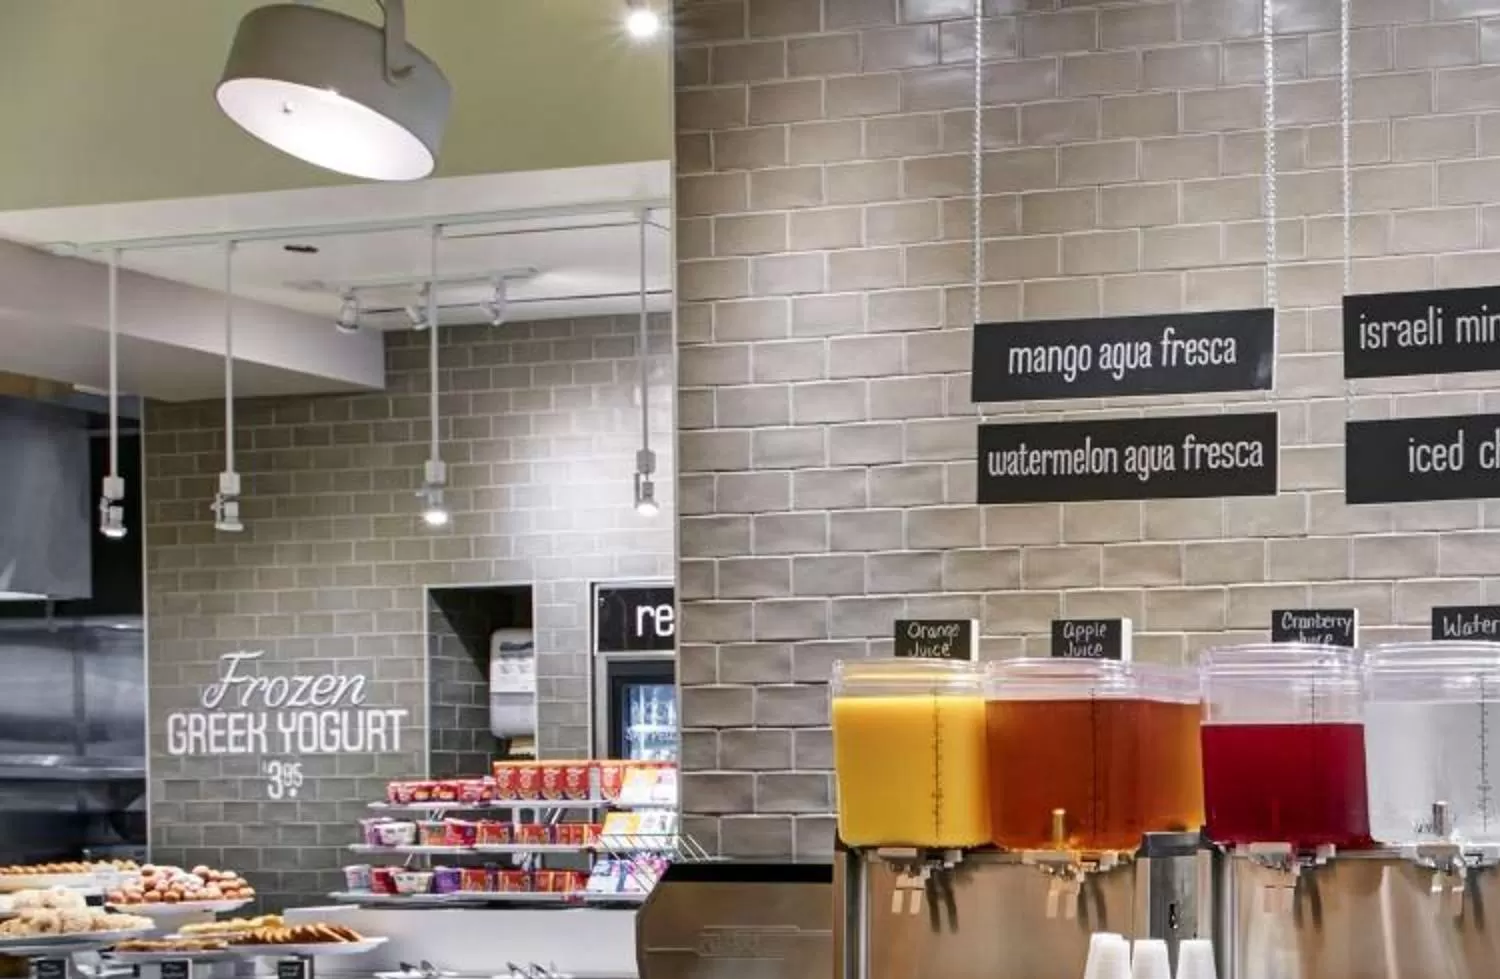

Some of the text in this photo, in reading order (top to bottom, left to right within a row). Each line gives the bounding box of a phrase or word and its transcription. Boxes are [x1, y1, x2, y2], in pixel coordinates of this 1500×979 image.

[1359, 305, 1443, 350] israeli
[1008, 326, 1237, 382] mango agua fresca
[988, 433, 1264, 481] watermelon agua fresca
[1408, 428, 1465, 473] iced
[907, 622, 961, 645] Orange
[1281, 611, 1354, 637] Cranberry
[203, 650, 368, 708] Frozen
[168, 709, 409, 755] GREEK YOGURT
